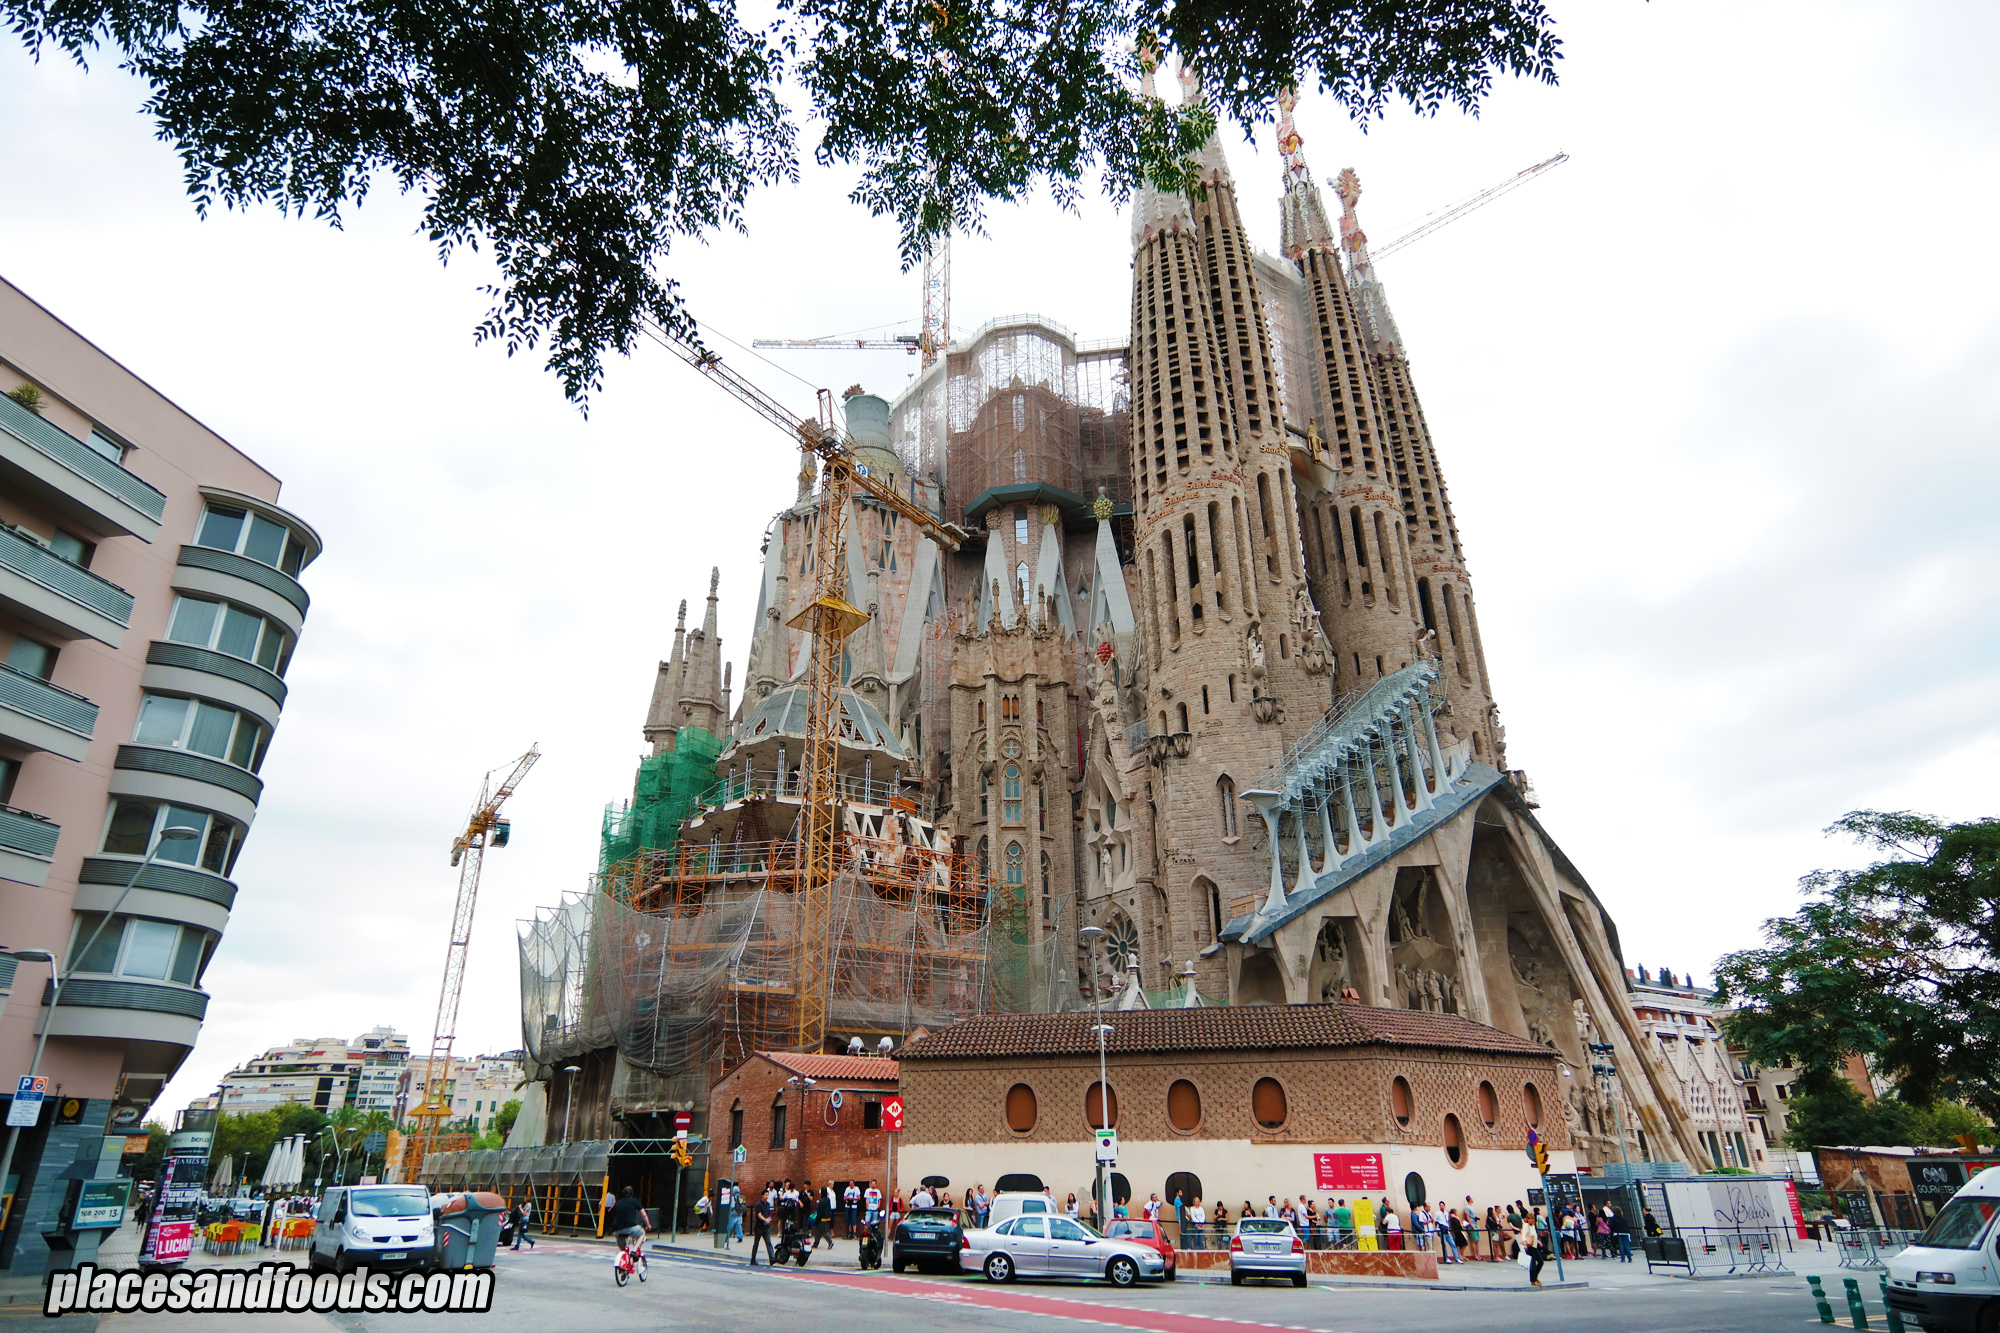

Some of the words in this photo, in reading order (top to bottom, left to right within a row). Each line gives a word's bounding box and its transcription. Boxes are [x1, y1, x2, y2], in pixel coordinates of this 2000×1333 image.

[1211, 470, 1242, 487] Sanctus
[1186, 479, 1224, 491] Sanctus
[1163, 491, 1201, 507] Sanctus
[1364, 492, 1395, 502] Sanctus
[1145, 507, 1175, 526] Sanctus
[1432, 564, 1463, 574] Sanctus
[21, 1078, 31, 1089] P
[892, 1105, 899, 1113] M
